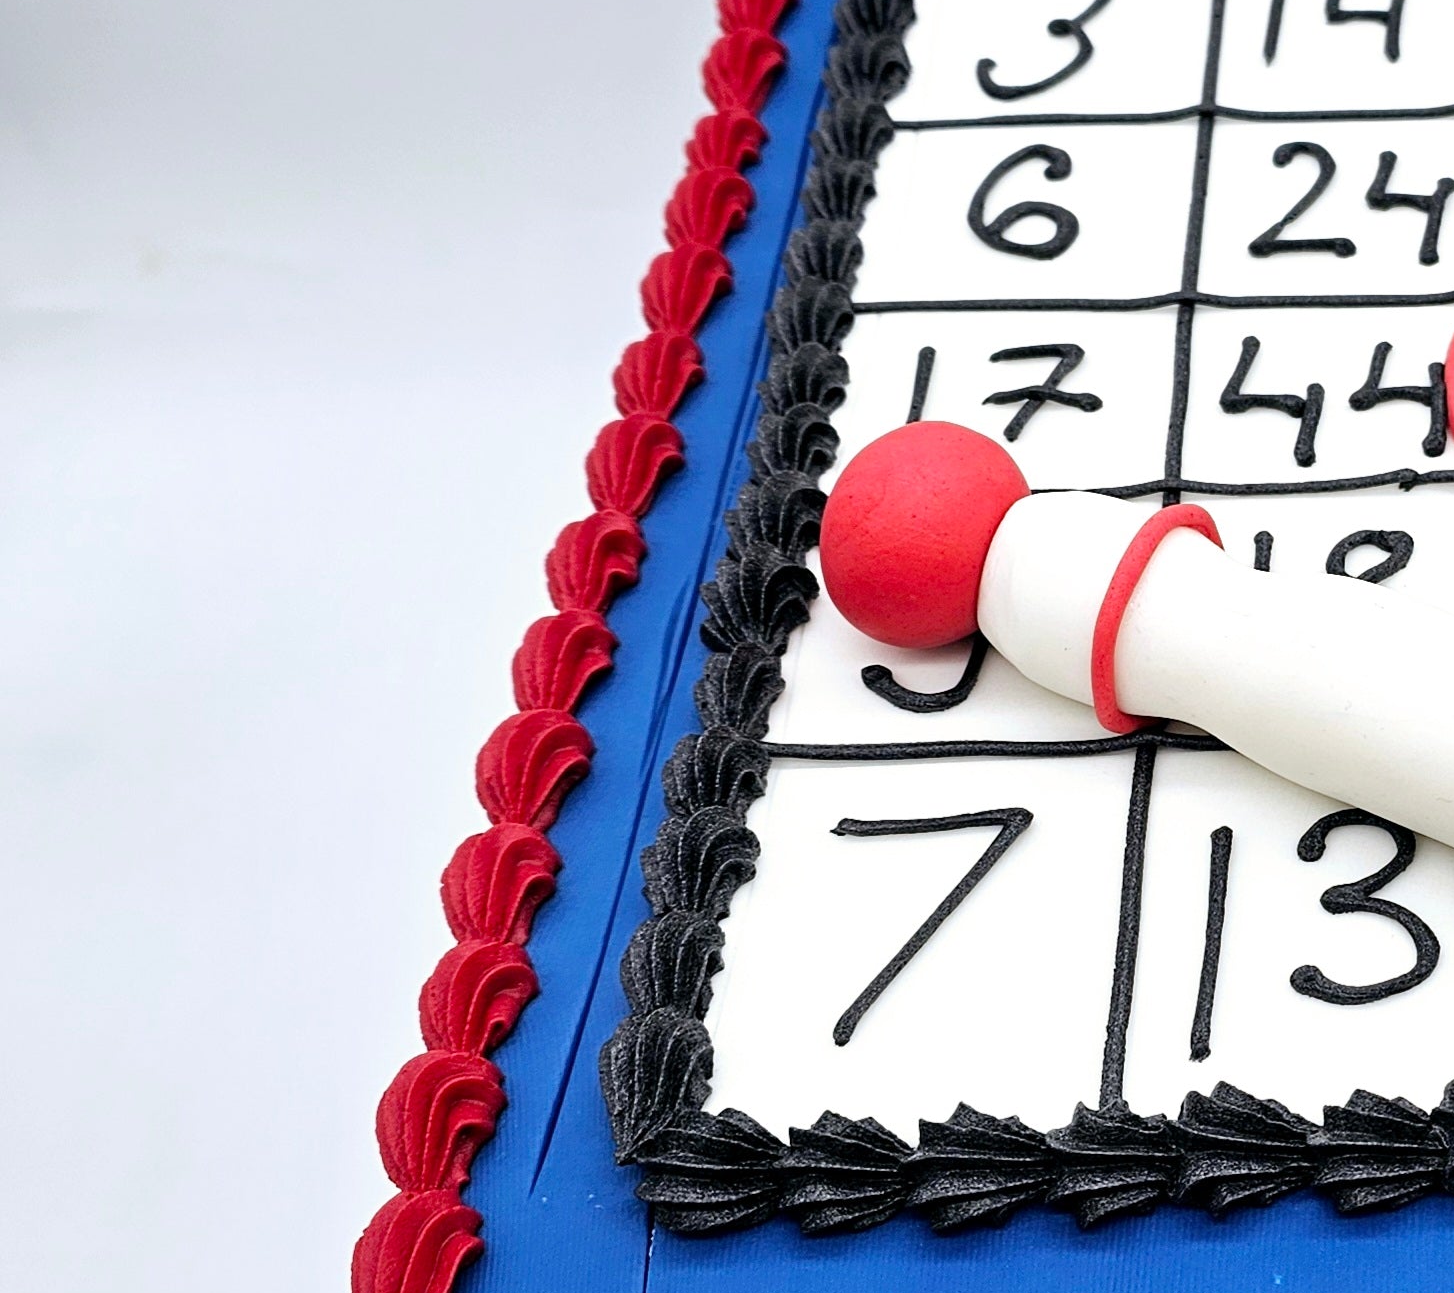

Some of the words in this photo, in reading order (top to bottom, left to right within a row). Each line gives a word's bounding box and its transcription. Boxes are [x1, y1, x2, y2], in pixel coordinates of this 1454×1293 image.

[967, 143, 1079, 261] 6
[905, 343, 1103, 443] 17
[1218, 335, 1446, 467] 44
[829, 806, 1034, 1047] 7
[1189, 808, 1441, 1063] 13
